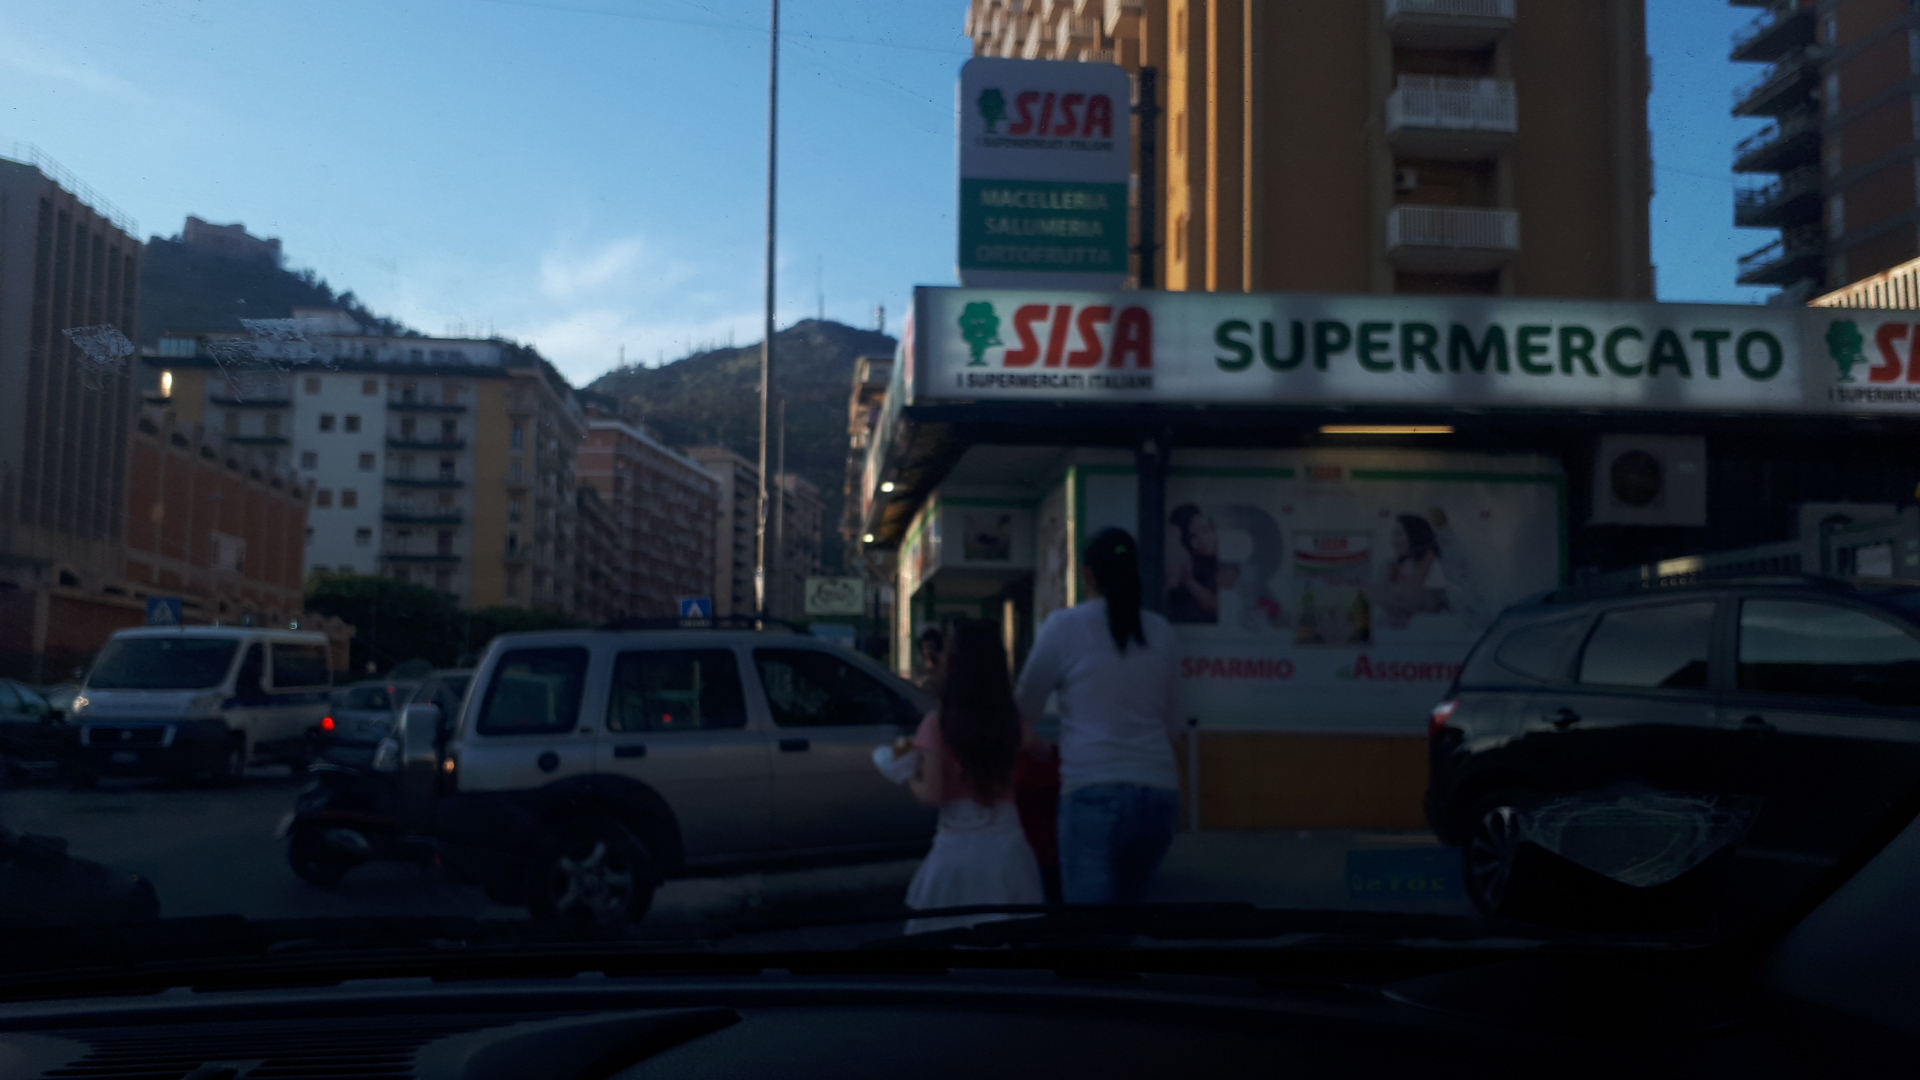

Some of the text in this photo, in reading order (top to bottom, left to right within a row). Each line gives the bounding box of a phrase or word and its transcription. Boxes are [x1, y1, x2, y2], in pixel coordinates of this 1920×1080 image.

[1009, 91, 1112, 137] SISA
[980, 189, 1109, 210] MACELLERIA
[984, 217, 1103, 237] SALUMERIA
[976, 244, 1112, 264] ORTOFRUTTA
[1003, 305, 1153, 369] SISA
[1214, 320, 1783, 380] SUPERMERCATO
[967, 373, 1083, 389] SUPERMERCATI
[1088, 374, 1153, 390] ITALIANI
